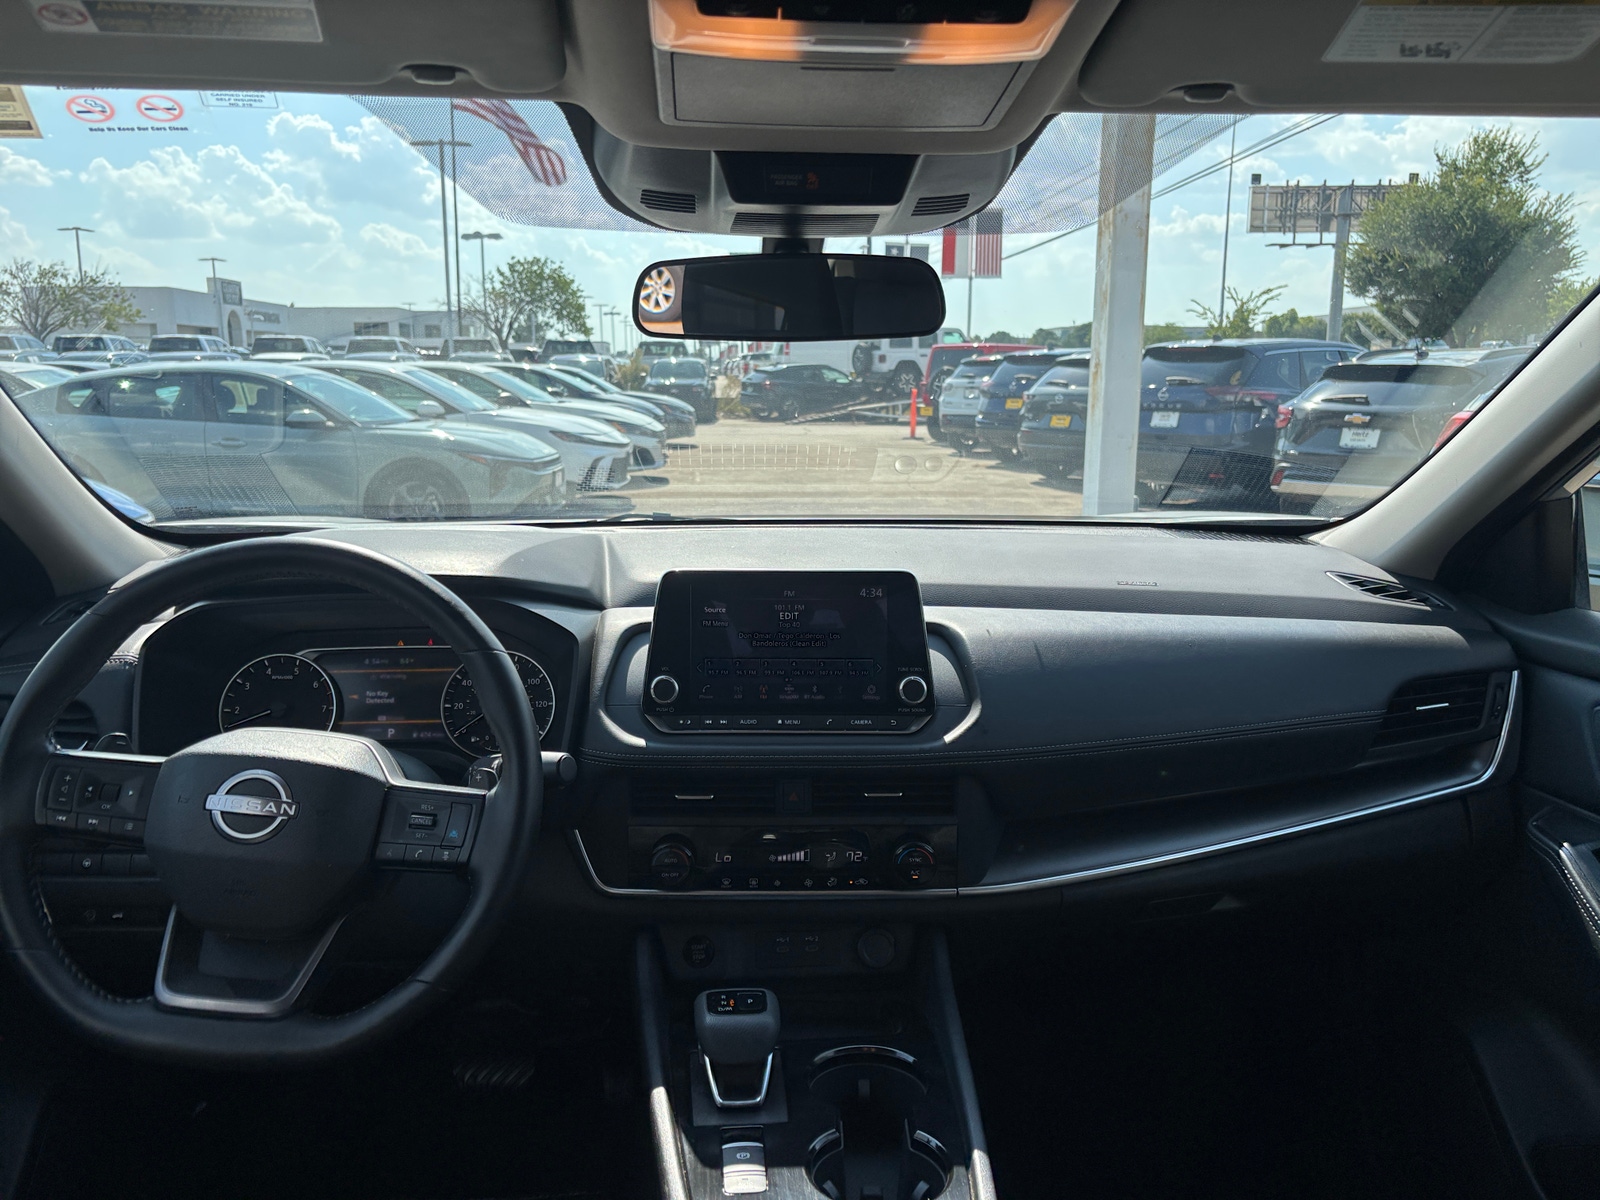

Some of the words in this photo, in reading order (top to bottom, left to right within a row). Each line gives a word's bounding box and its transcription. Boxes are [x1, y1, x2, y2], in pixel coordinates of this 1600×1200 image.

[859, 587, 883, 598] 4:34
[779, 612, 800, 620] EDIT
[778, 621, 791, 630] Top
[778, 632, 794, 641] Tego
[789, 640, 810, 648] (Clean
[811, 640, 827, 648] Edit)
[376, 690, 389, 698] Key
[388, 728, 395, 738] P
[208, 796, 297, 816] NISSAN
[410, 817, 433, 825] CANCEL
